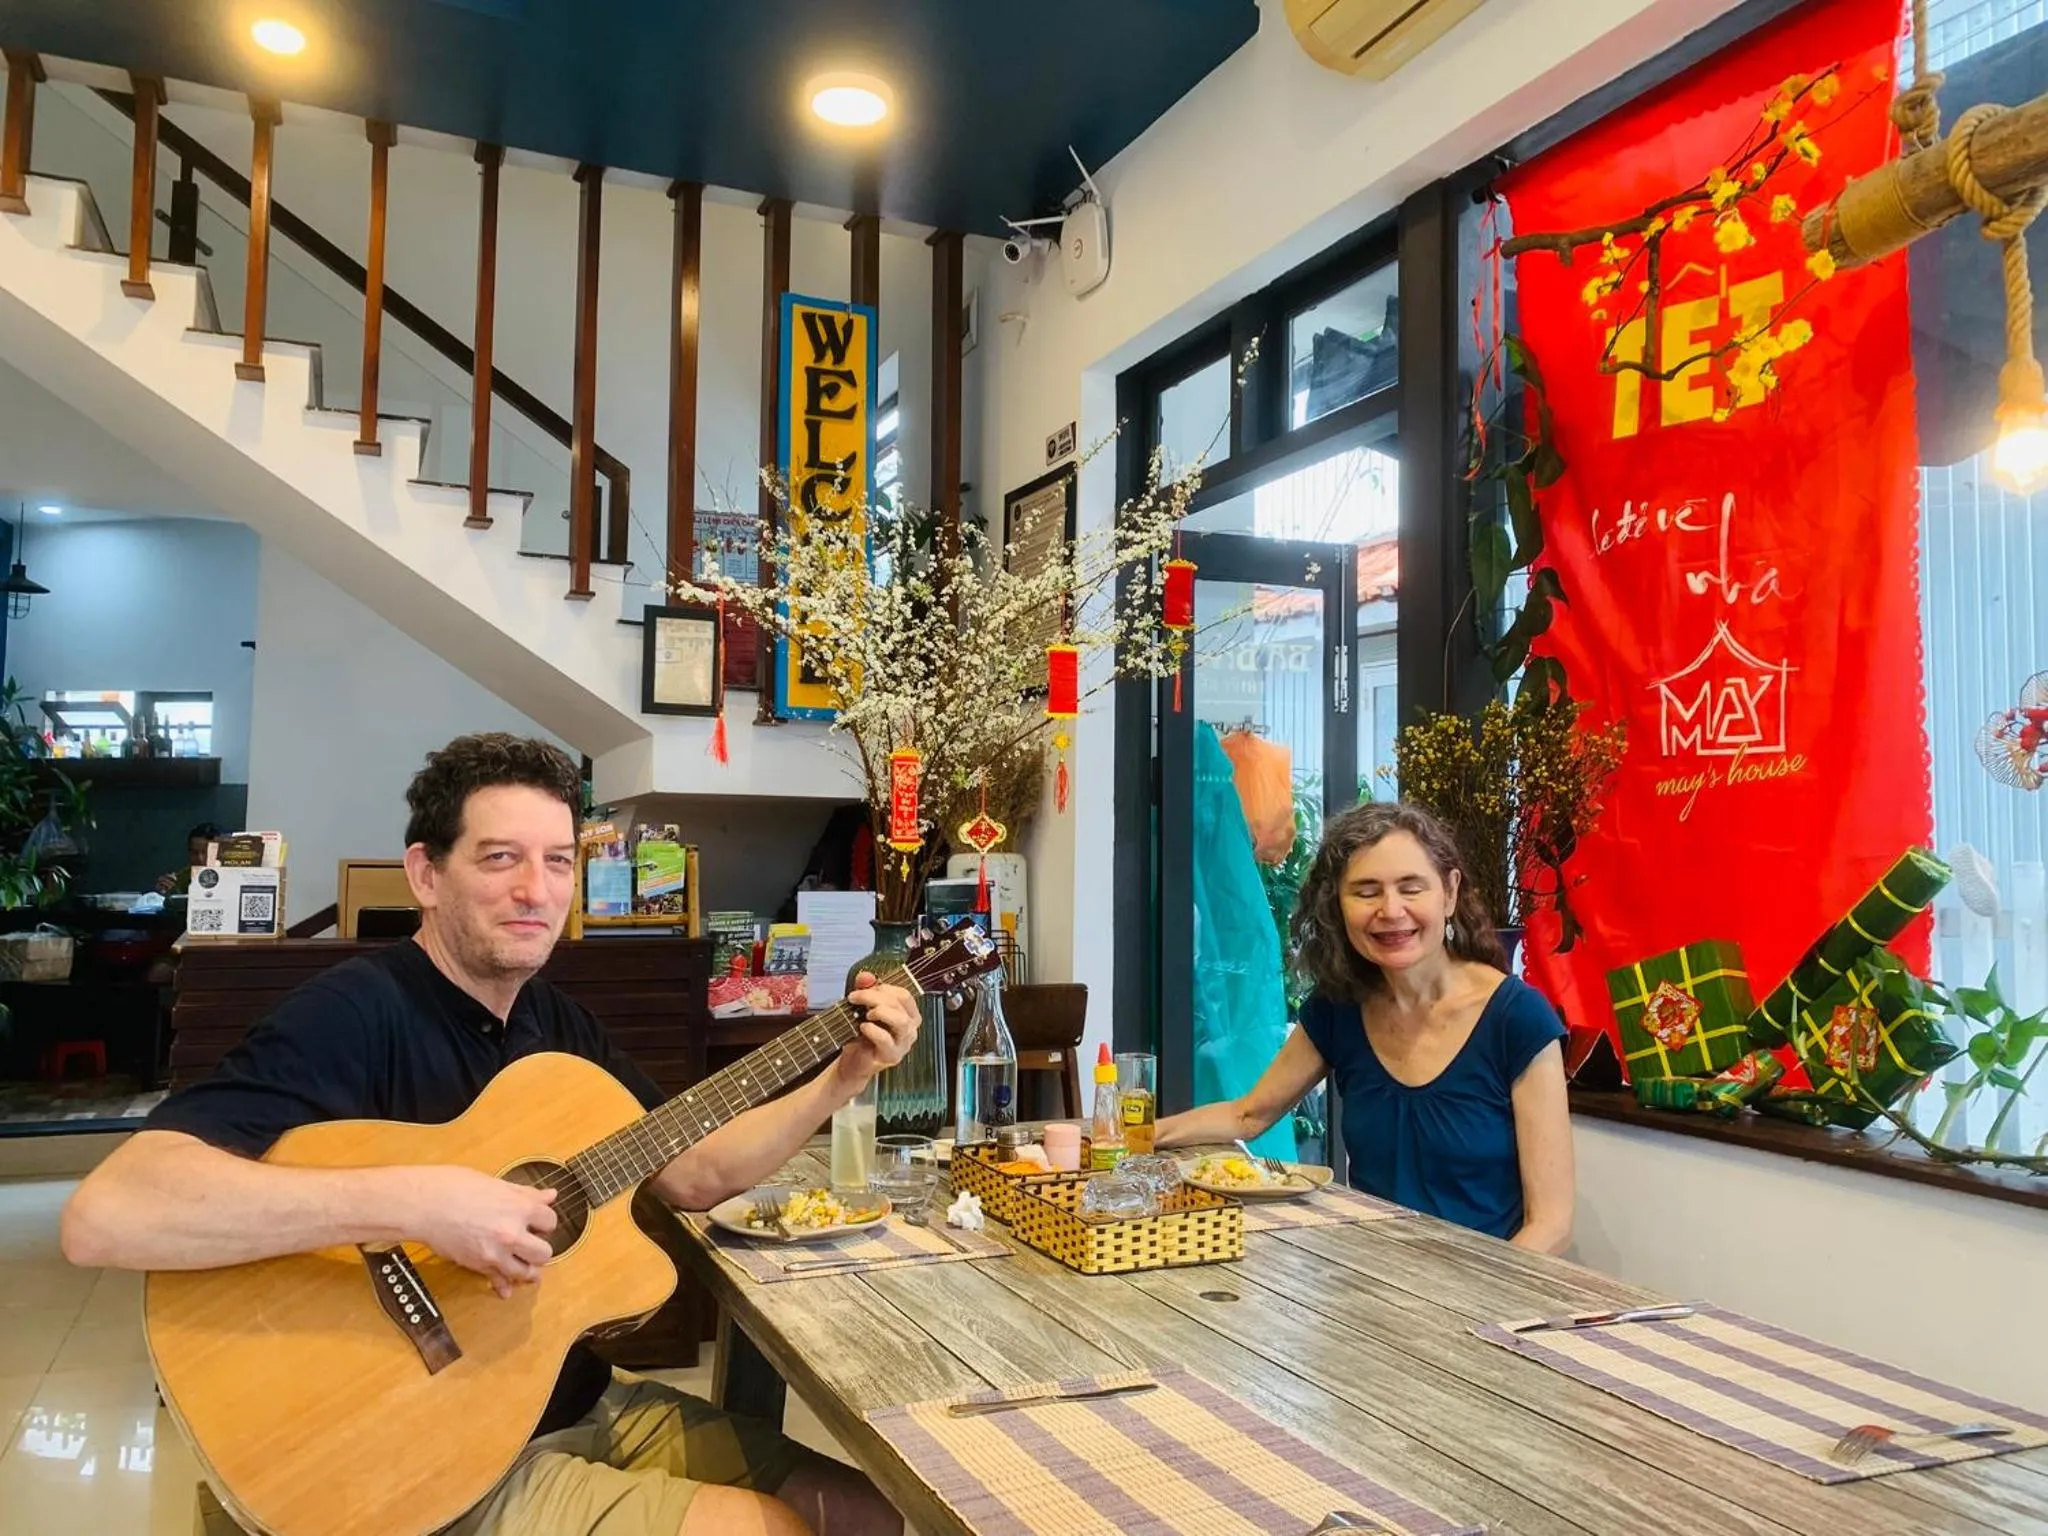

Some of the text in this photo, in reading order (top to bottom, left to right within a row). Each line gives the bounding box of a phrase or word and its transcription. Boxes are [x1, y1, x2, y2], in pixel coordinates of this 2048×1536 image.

[799, 311, 858, 685] WELC
[1656, 743, 1807, 822] may's house
